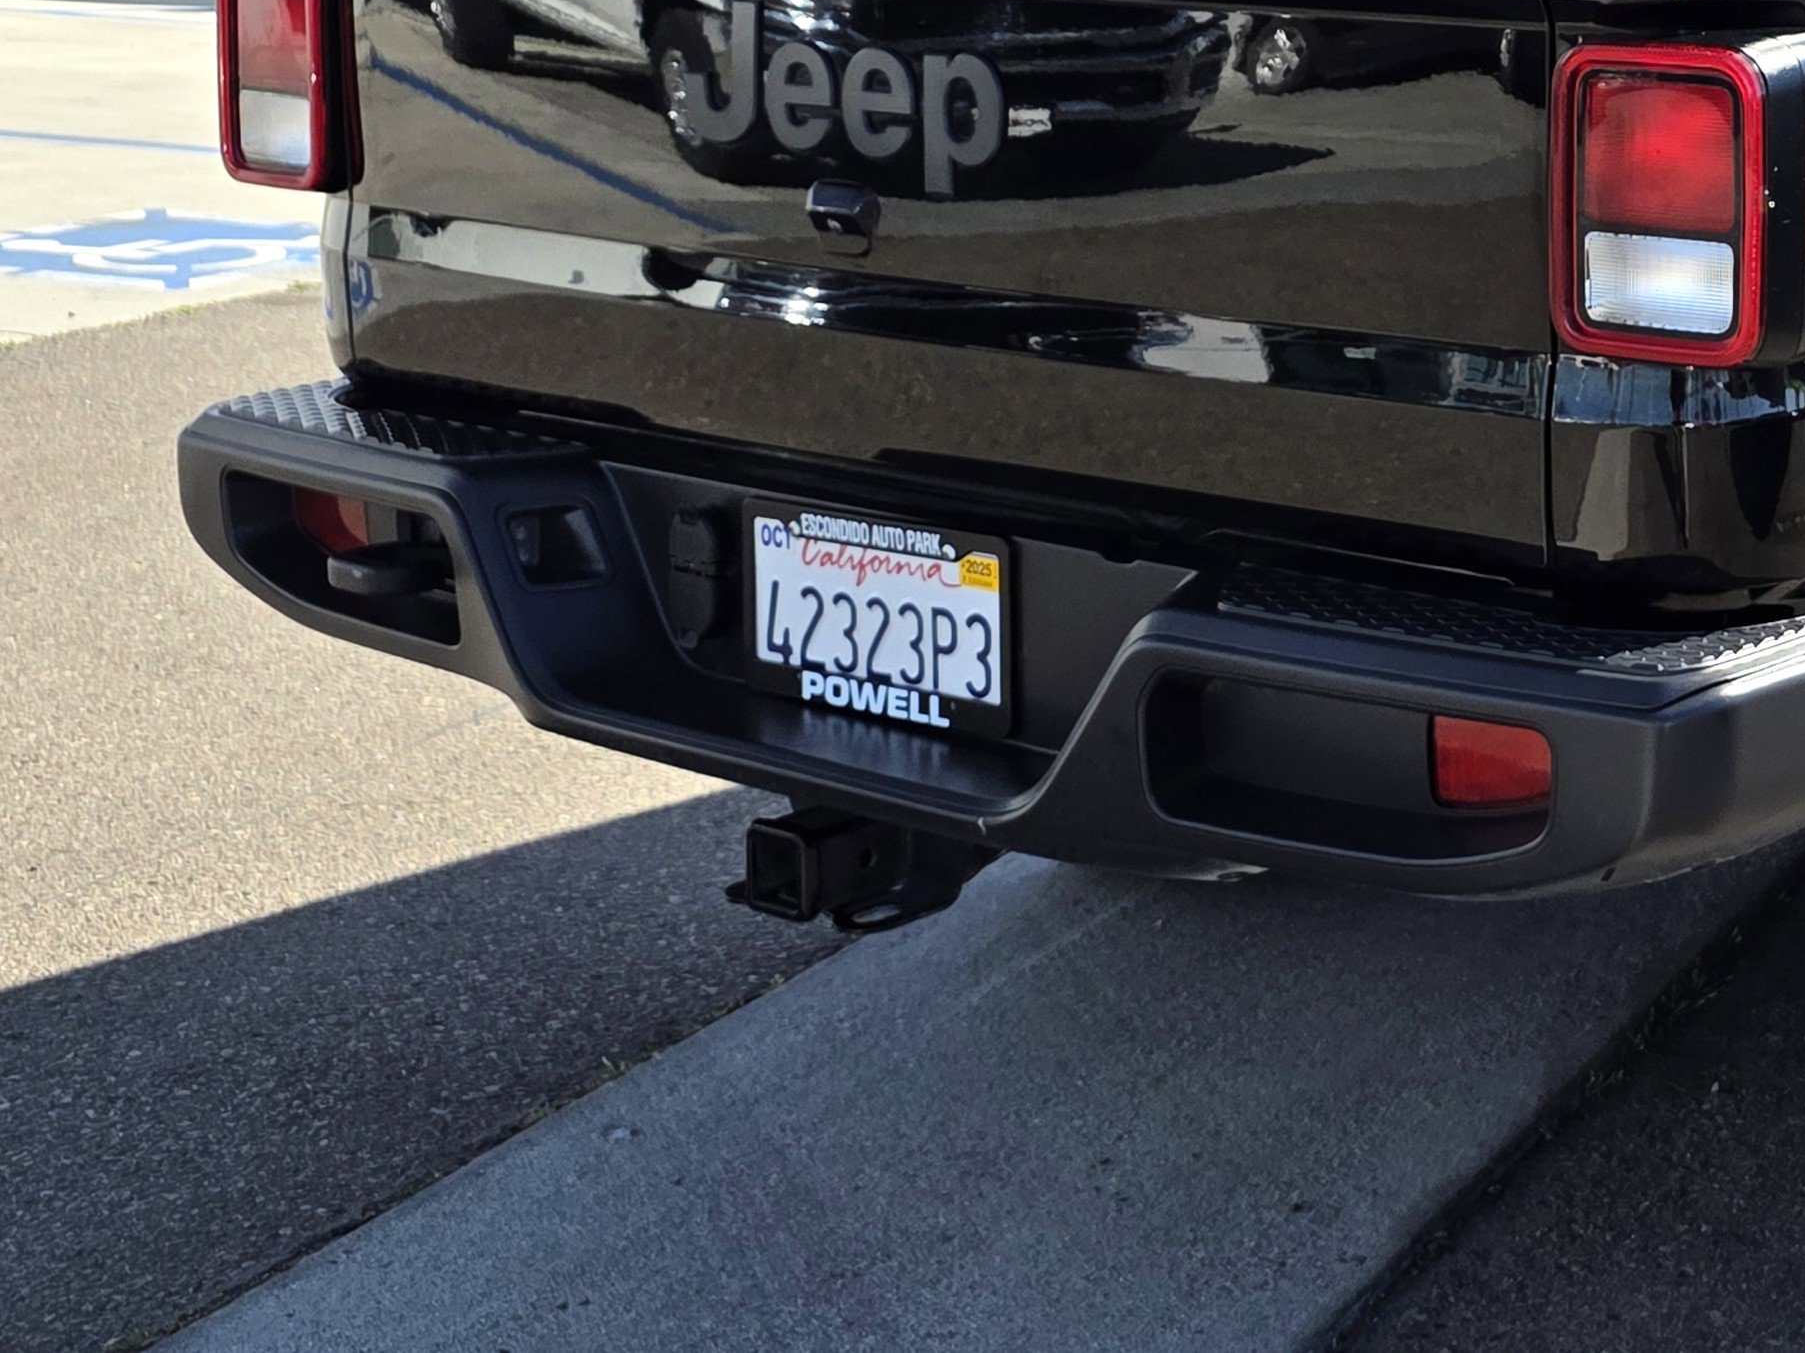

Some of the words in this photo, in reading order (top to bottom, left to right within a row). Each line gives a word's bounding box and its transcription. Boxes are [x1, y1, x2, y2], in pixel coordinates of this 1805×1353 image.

[683, 0, 1001, 196] Jeep
[761, 523, 791, 549] OCT
[802, 513, 869, 544] ESCONDIDO
[872, 525, 904, 550] AUTO
[906, 530, 941, 555] PARK
[802, 539, 962, 588] California
[966, 559, 992, 577] 2025
[767, 580, 991, 697] 42323P3
[802, 671, 949, 727] POWELL
